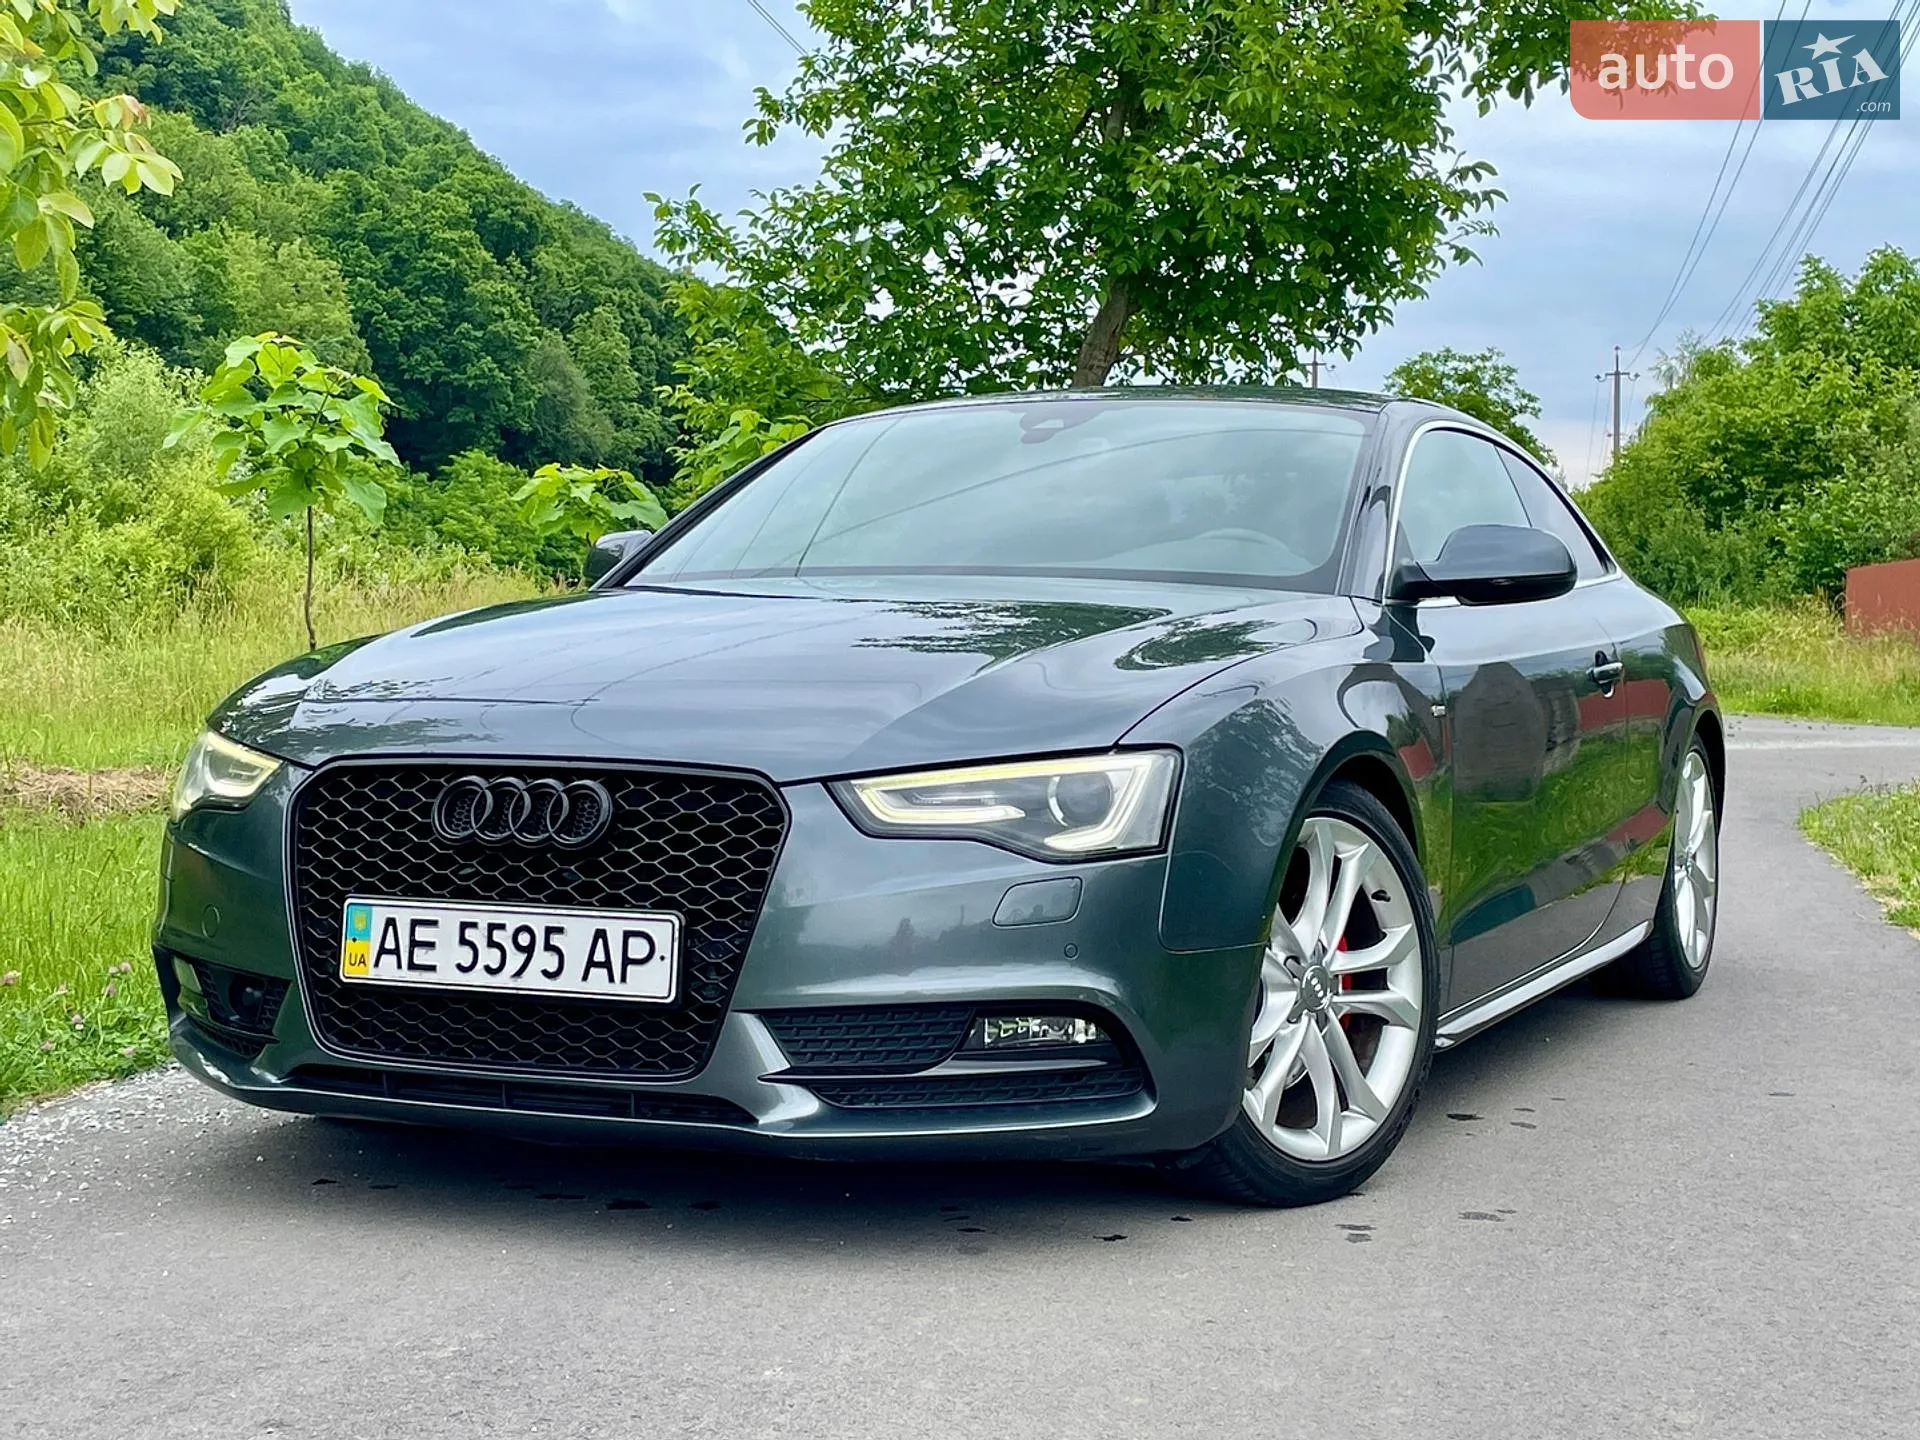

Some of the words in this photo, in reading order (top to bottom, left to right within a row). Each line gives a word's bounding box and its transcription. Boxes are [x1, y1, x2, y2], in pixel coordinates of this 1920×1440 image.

[348, 953, 367, 968] UA
[373, 916, 440, 972] AE
[455, 920, 565, 980] 5595
[581, 928, 657, 984] AP
